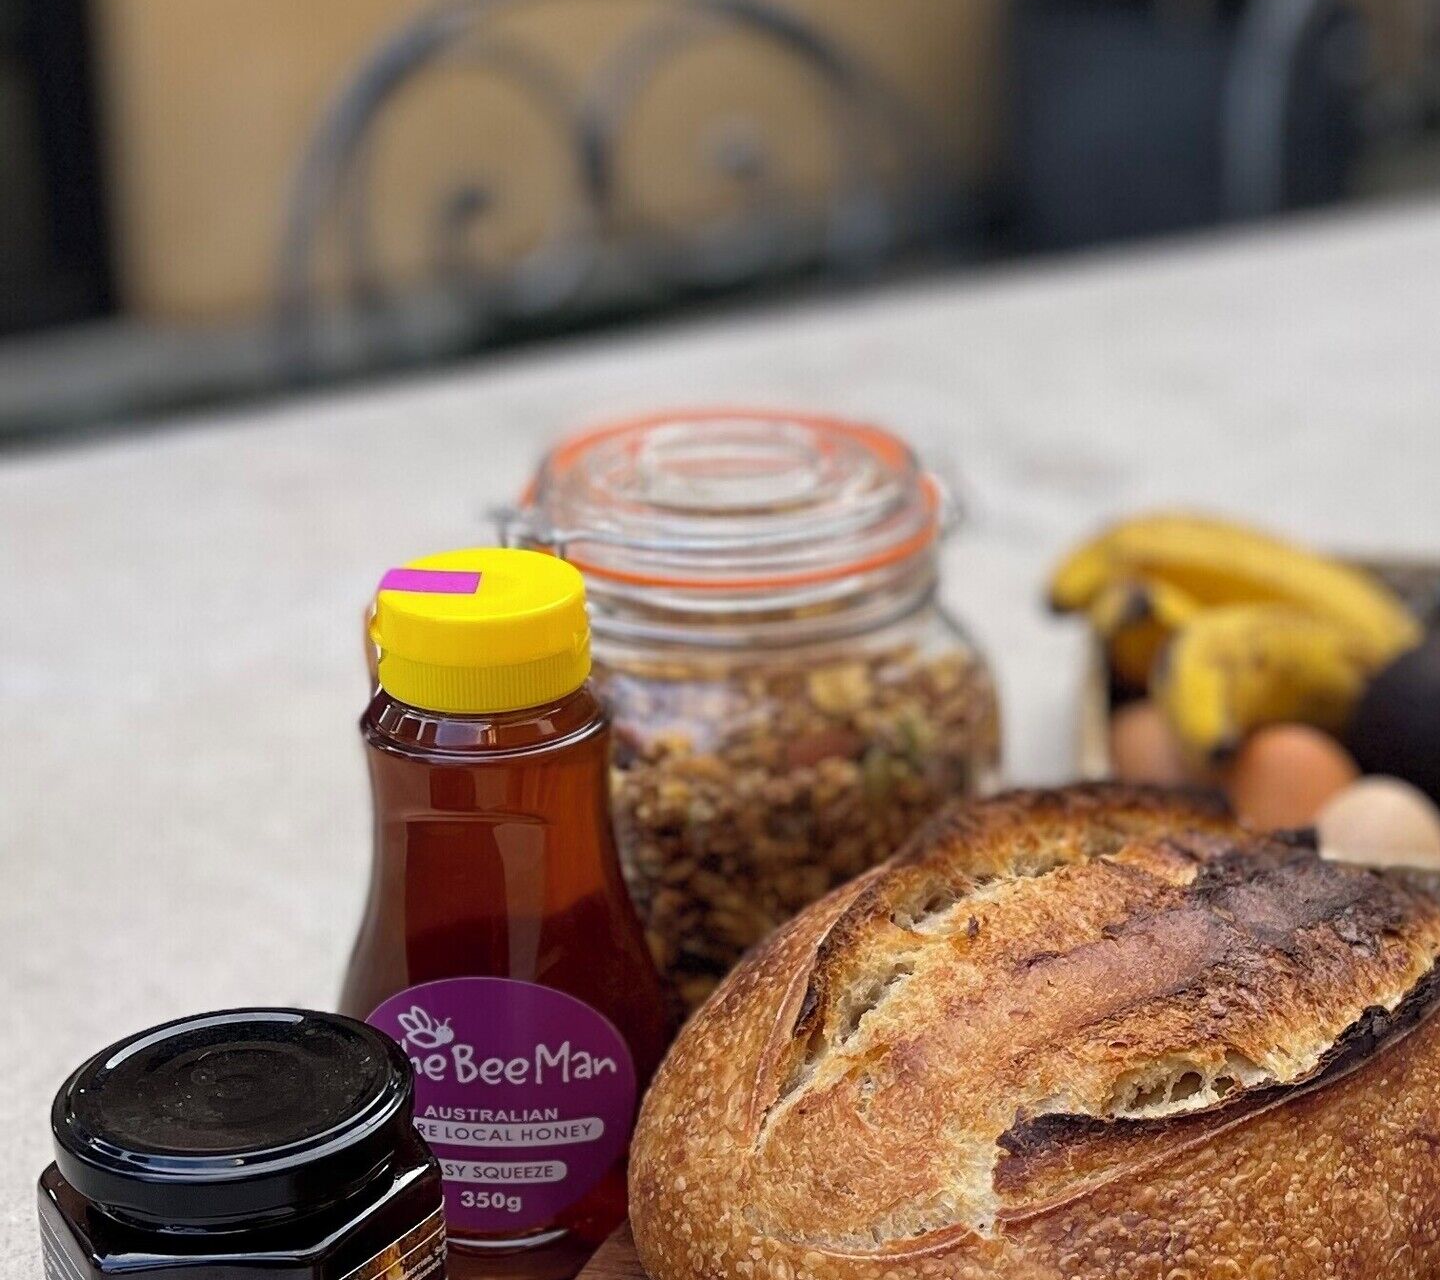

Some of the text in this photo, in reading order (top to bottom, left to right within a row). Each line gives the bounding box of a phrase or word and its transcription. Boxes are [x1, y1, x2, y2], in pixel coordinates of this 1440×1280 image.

[396, 1039, 618, 1085] he Bee Man
[424, 1104, 559, 1122] AUSTRALIAN
[415, 1122, 594, 1142] RE LOCAL HONEY
[473, 1165, 554, 1179] SQUEEZE
[460, 1190, 522, 1213] 350g
